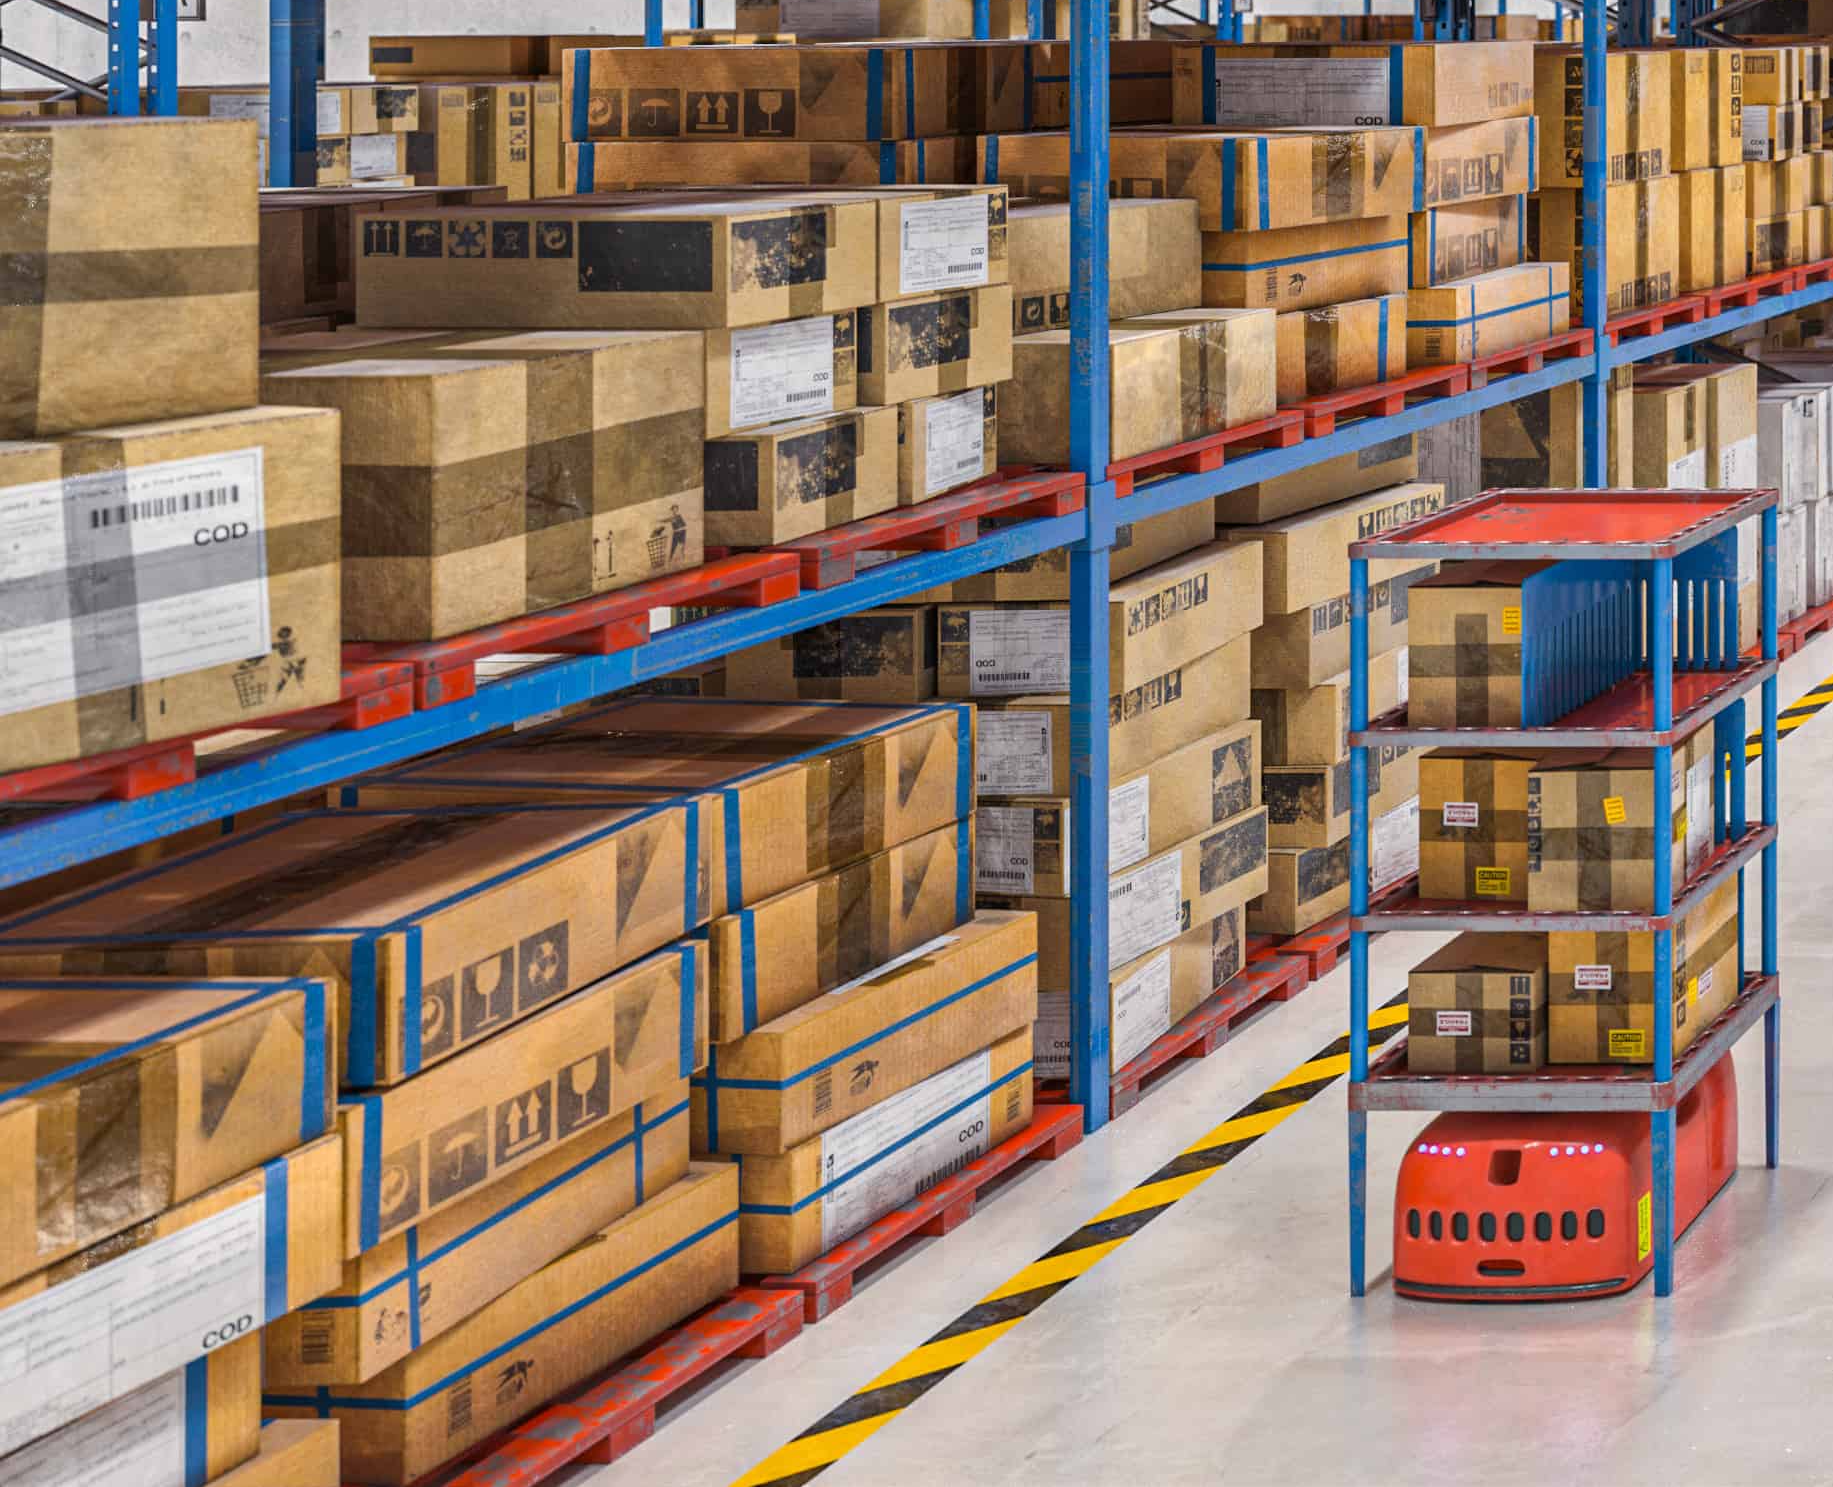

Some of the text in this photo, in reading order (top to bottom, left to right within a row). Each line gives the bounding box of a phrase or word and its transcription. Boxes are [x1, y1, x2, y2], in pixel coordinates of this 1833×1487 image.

[1354, 116, 1383, 126] COD
[194, 521, 249, 546] COD
[1009, 857, 1028, 866] COD
[959, 1120, 983, 1143] COD
[202, 1314, 252, 1350] COD
